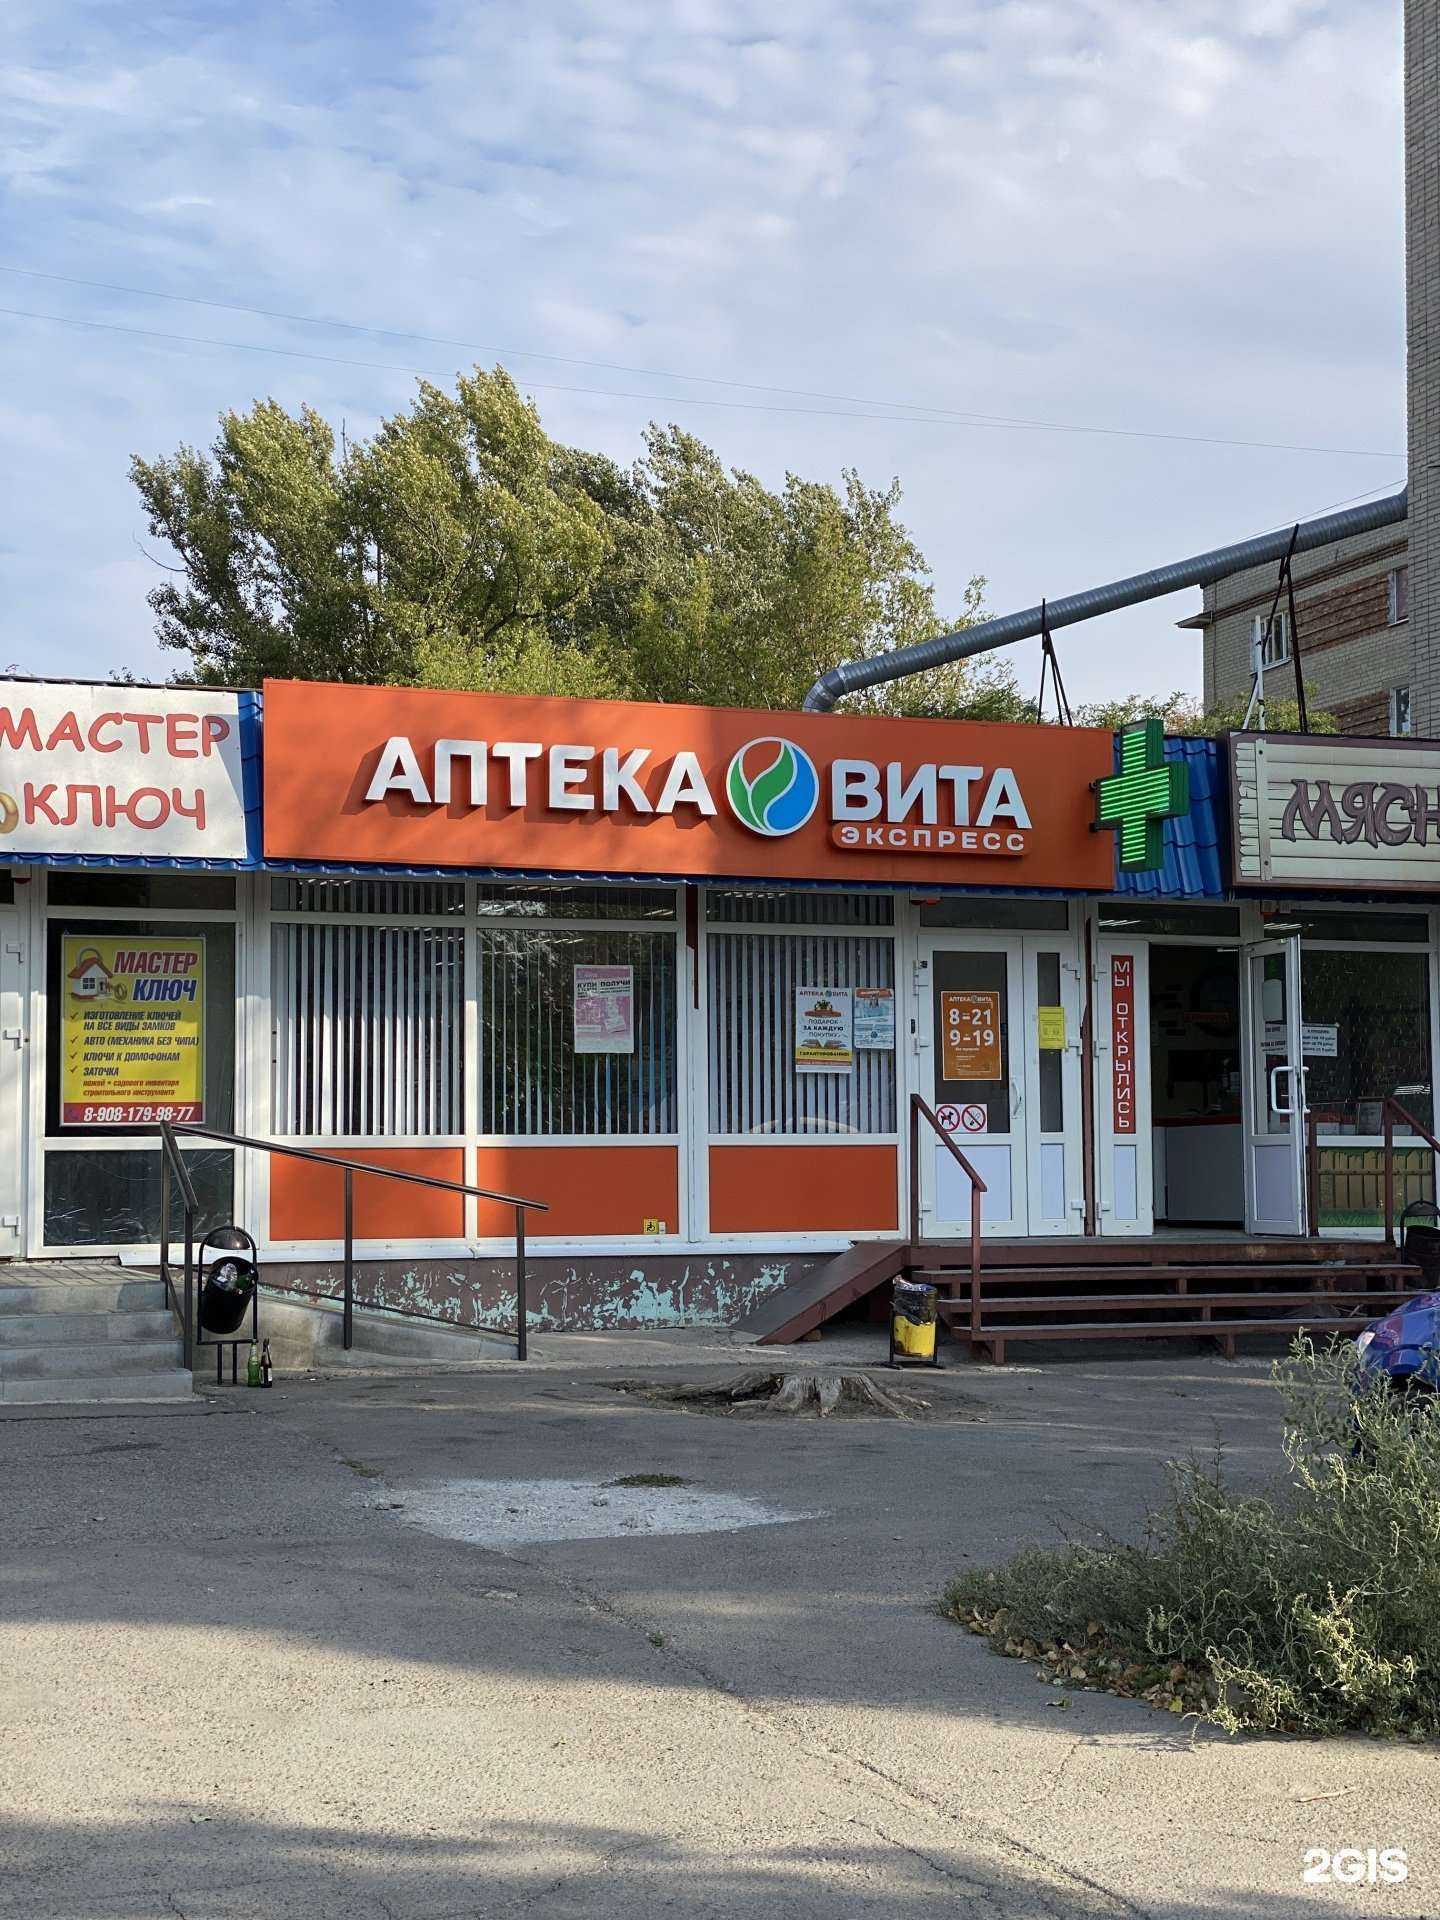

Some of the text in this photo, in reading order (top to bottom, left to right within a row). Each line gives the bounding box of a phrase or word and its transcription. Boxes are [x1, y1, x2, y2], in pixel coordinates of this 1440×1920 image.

[0, 706, 230, 758] МАСТЕР
[365, 736, 1032, 829] АПТЕКА ВИТА
[24, 782, 206, 830] КЛЮЧ
[1281, 778, 1440, 849] МЯСН
[840, 826, 1025, 851] ЭКСПРЕСС
[114, 951, 199, 974] МАСТЕР
[1114, 960, 1130, 987] МЫ
[133, 979, 198, 1001] КЛЮЧ
[84, 1010, 182, 1020] ИЗГОТОВЛЕНИЕ КЛЮЧЕЙ
[84, 1022, 176, 1032] НА ВСЕ ВИДЫ ЗАМКОВ
[84, 1036, 199, 1046] АВТО (МЕХАНИКА БЕЗ ЧИПА)
[83, 1052, 114, 1061] КЛЮЧИ
[124, 1052, 180, 1062] ДОМОФОНАМ
[1115, 1002, 1131, 1128] ОТКРЫЛИСЬ
[83, 1067, 119, 1076] ЗАТОЧКА
[83, 1106, 194, 1121] 8-908-179-98-77
